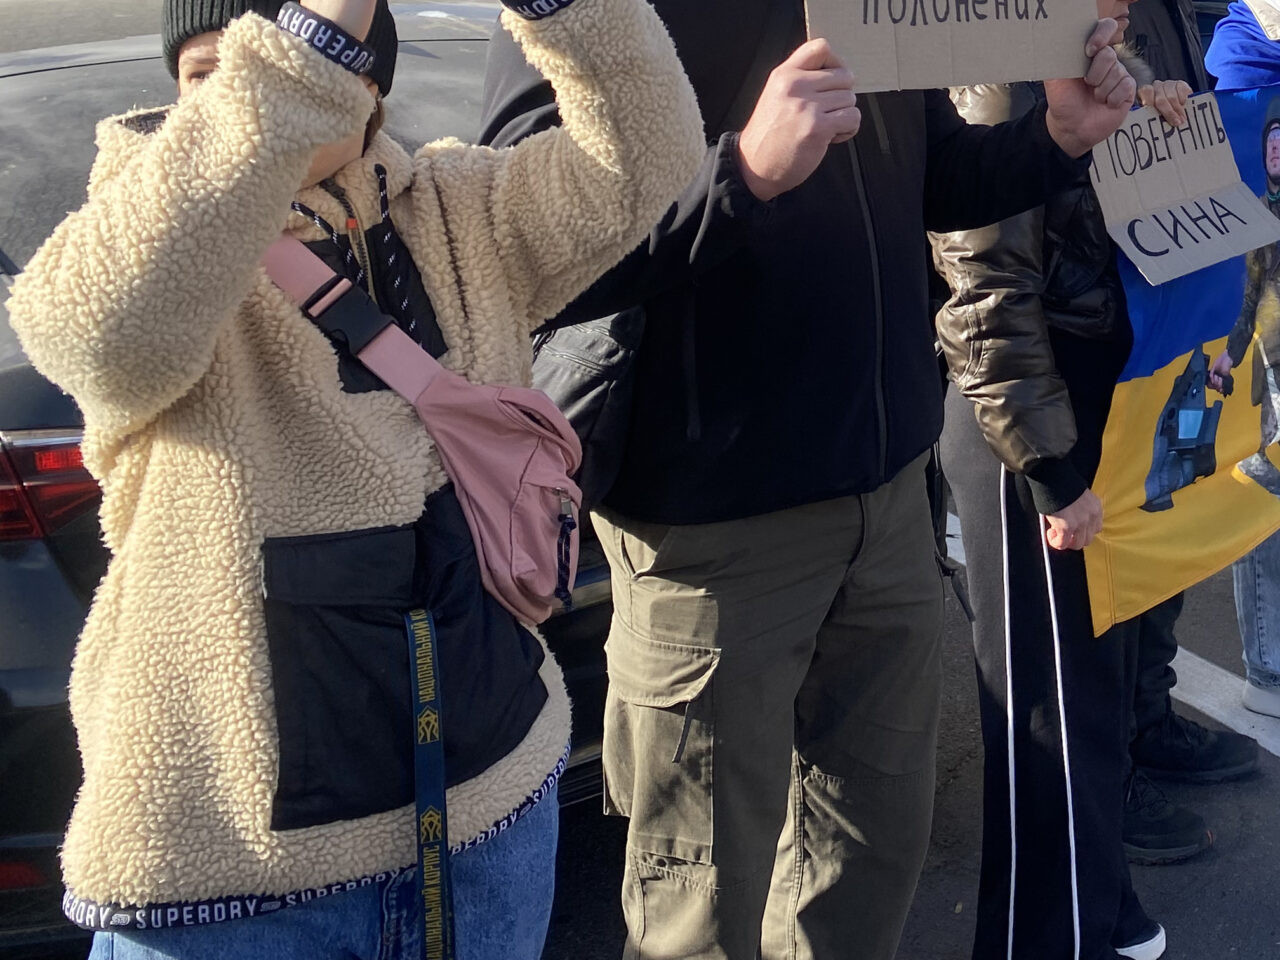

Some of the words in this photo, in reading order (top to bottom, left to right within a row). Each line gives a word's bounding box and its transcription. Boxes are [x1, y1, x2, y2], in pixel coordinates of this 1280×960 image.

[280, 8, 374, 72] SUPERDRY
[1128, 197, 1247, 257] СИНА
[411, 621, 436, 703] НАЦІОНАЛЬНИЙ
[423, 845, 440, 886] КОРПУС
[136, 899, 256, 929] SUPERDRY
[421, 886, 443, 960] АЦІОНАЛЬНИЙ
